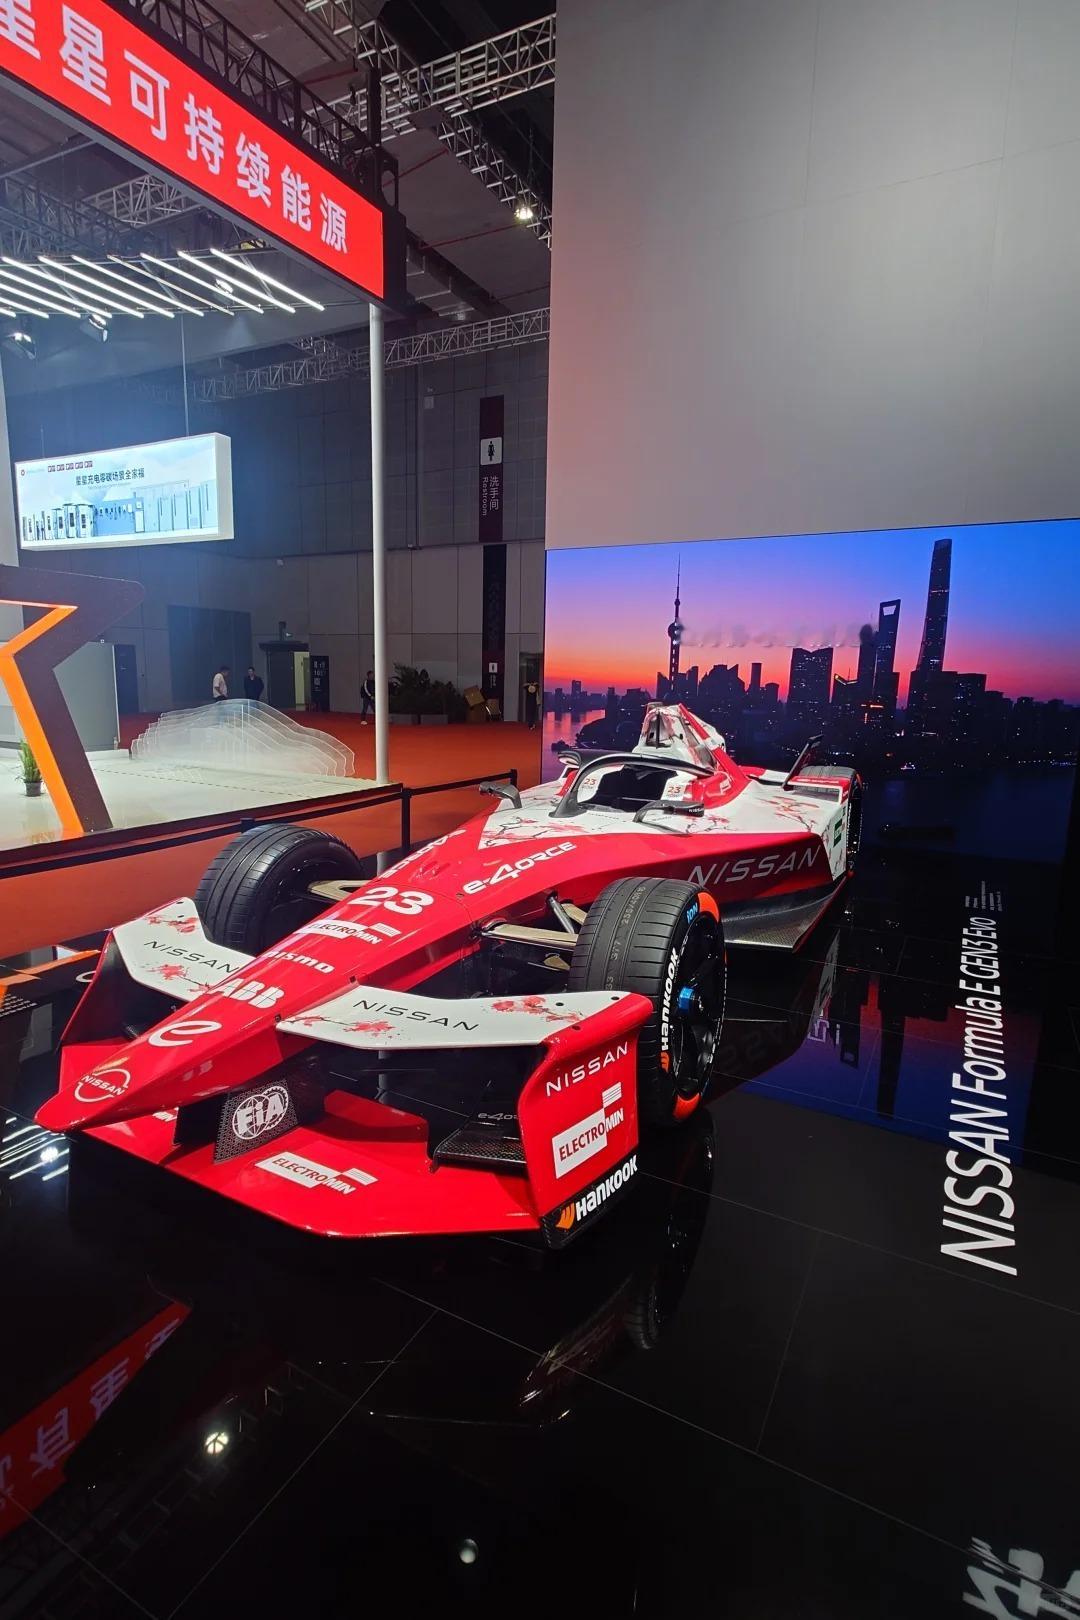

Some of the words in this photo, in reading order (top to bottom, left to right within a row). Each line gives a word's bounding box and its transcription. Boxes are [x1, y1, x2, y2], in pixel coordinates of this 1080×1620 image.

[490, 475, 500, 511] 洗手间
[687, 844, 821, 884] NISSAN
[347, 886, 434, 915] 23
[143, 940, 240, 974] NISSAN
[960, 938, 1001, 979] GEN3
[207, 978, 285, 1009] ABB
[959, 979, 1001, 996] E
[352, 999, 479, 1032] NISSAN
[951, 997, 1008, 1100] Formula
[81, 1074, 126, 1096] NISSAN
[545, 1041, 629, 1098] NISSAN
[558, 1107, 625, 1164] ELECTROMIN
[271, 1157, 356, 1196] ELECTROMIN
[940, 1098, 1018, 1276] NISSAN
